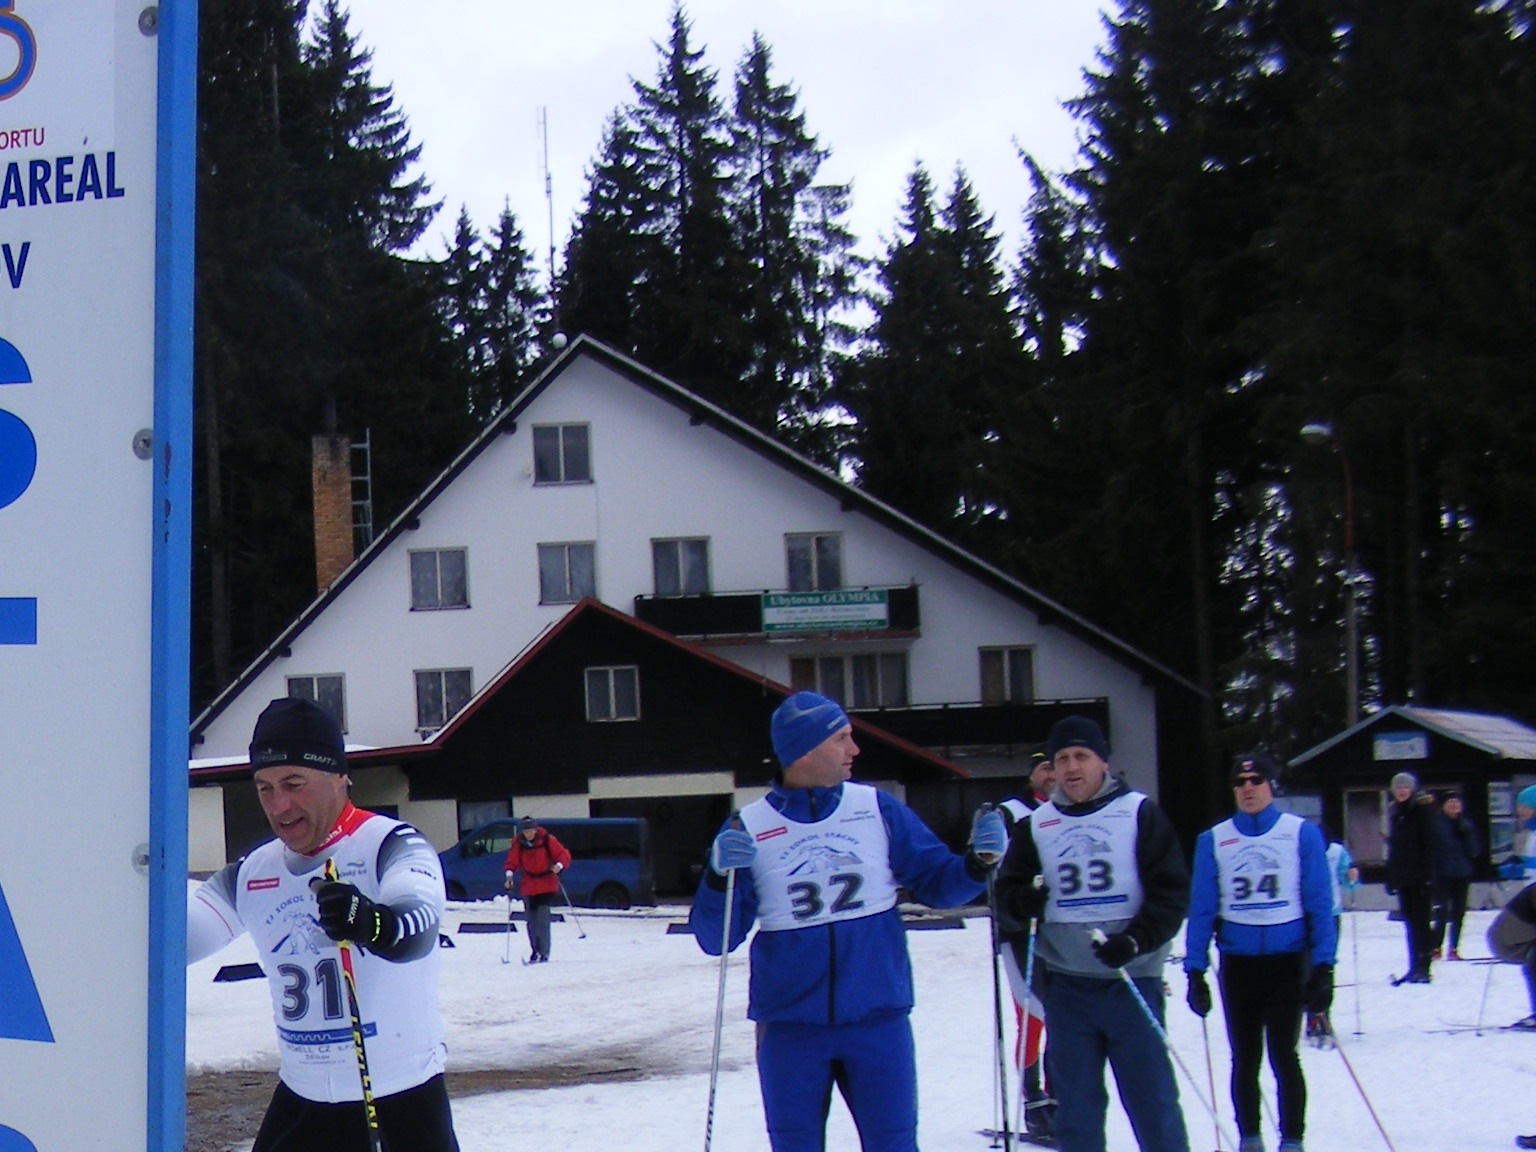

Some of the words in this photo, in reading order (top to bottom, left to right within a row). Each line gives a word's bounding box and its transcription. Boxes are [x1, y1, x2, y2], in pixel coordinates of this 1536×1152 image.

[823, 591, 880, 603] OLYMPIA
[303, 752, 333, 765] CRAFT
[1057, 859, 1115, 896] 33
[1231, 873, 1280, 901] 34
[275, 895, 305, 914] SOKOL
[786, 872, 866, 922] 32
[276, 957, 344, 1022] 31
